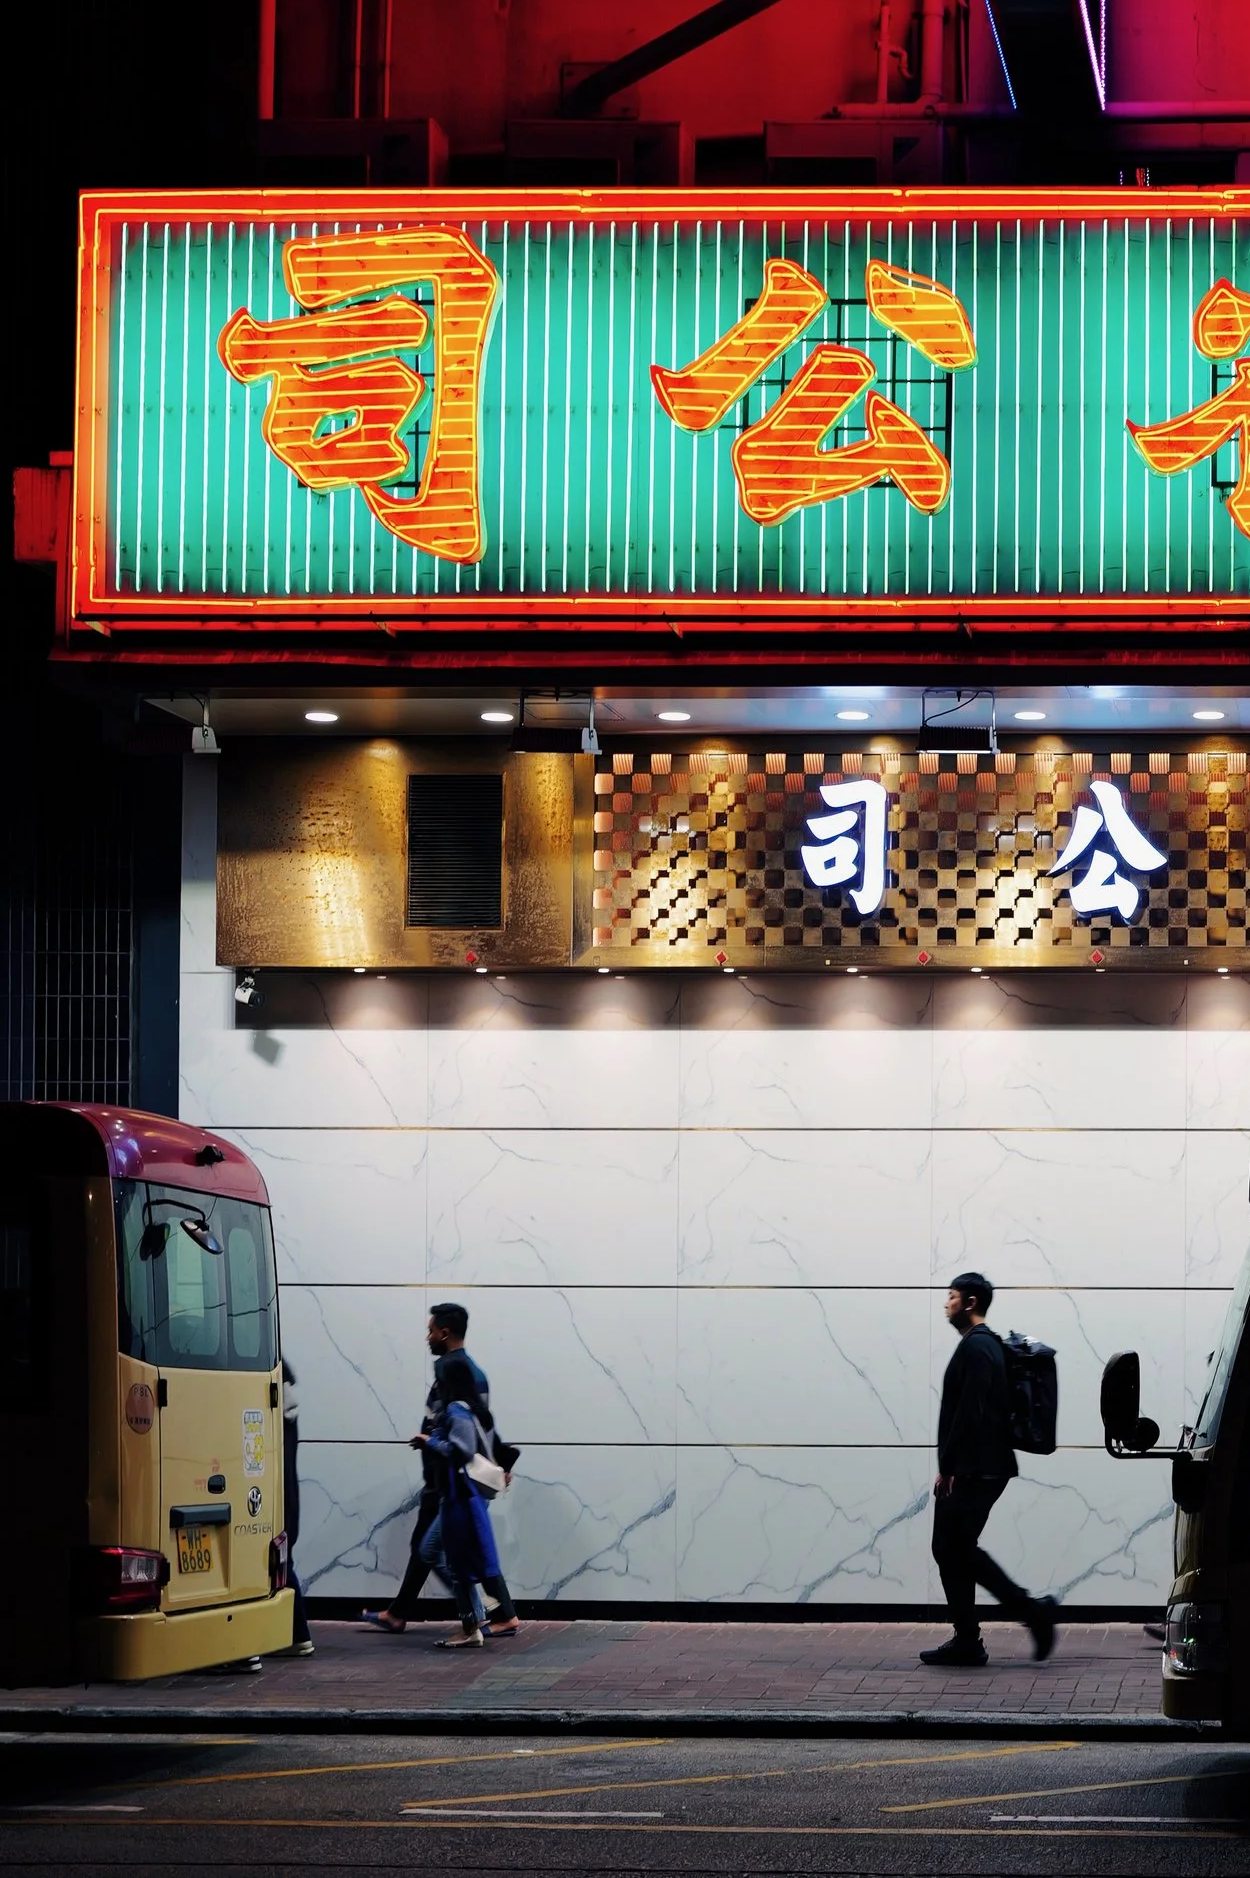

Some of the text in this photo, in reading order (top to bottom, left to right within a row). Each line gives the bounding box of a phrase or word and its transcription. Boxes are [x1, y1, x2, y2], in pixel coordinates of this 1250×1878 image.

[186, 1529, 202, 1550] WH
[234, 1523, 273, 1536] COASTER
[181, 1548, 211, 1572] 8689
